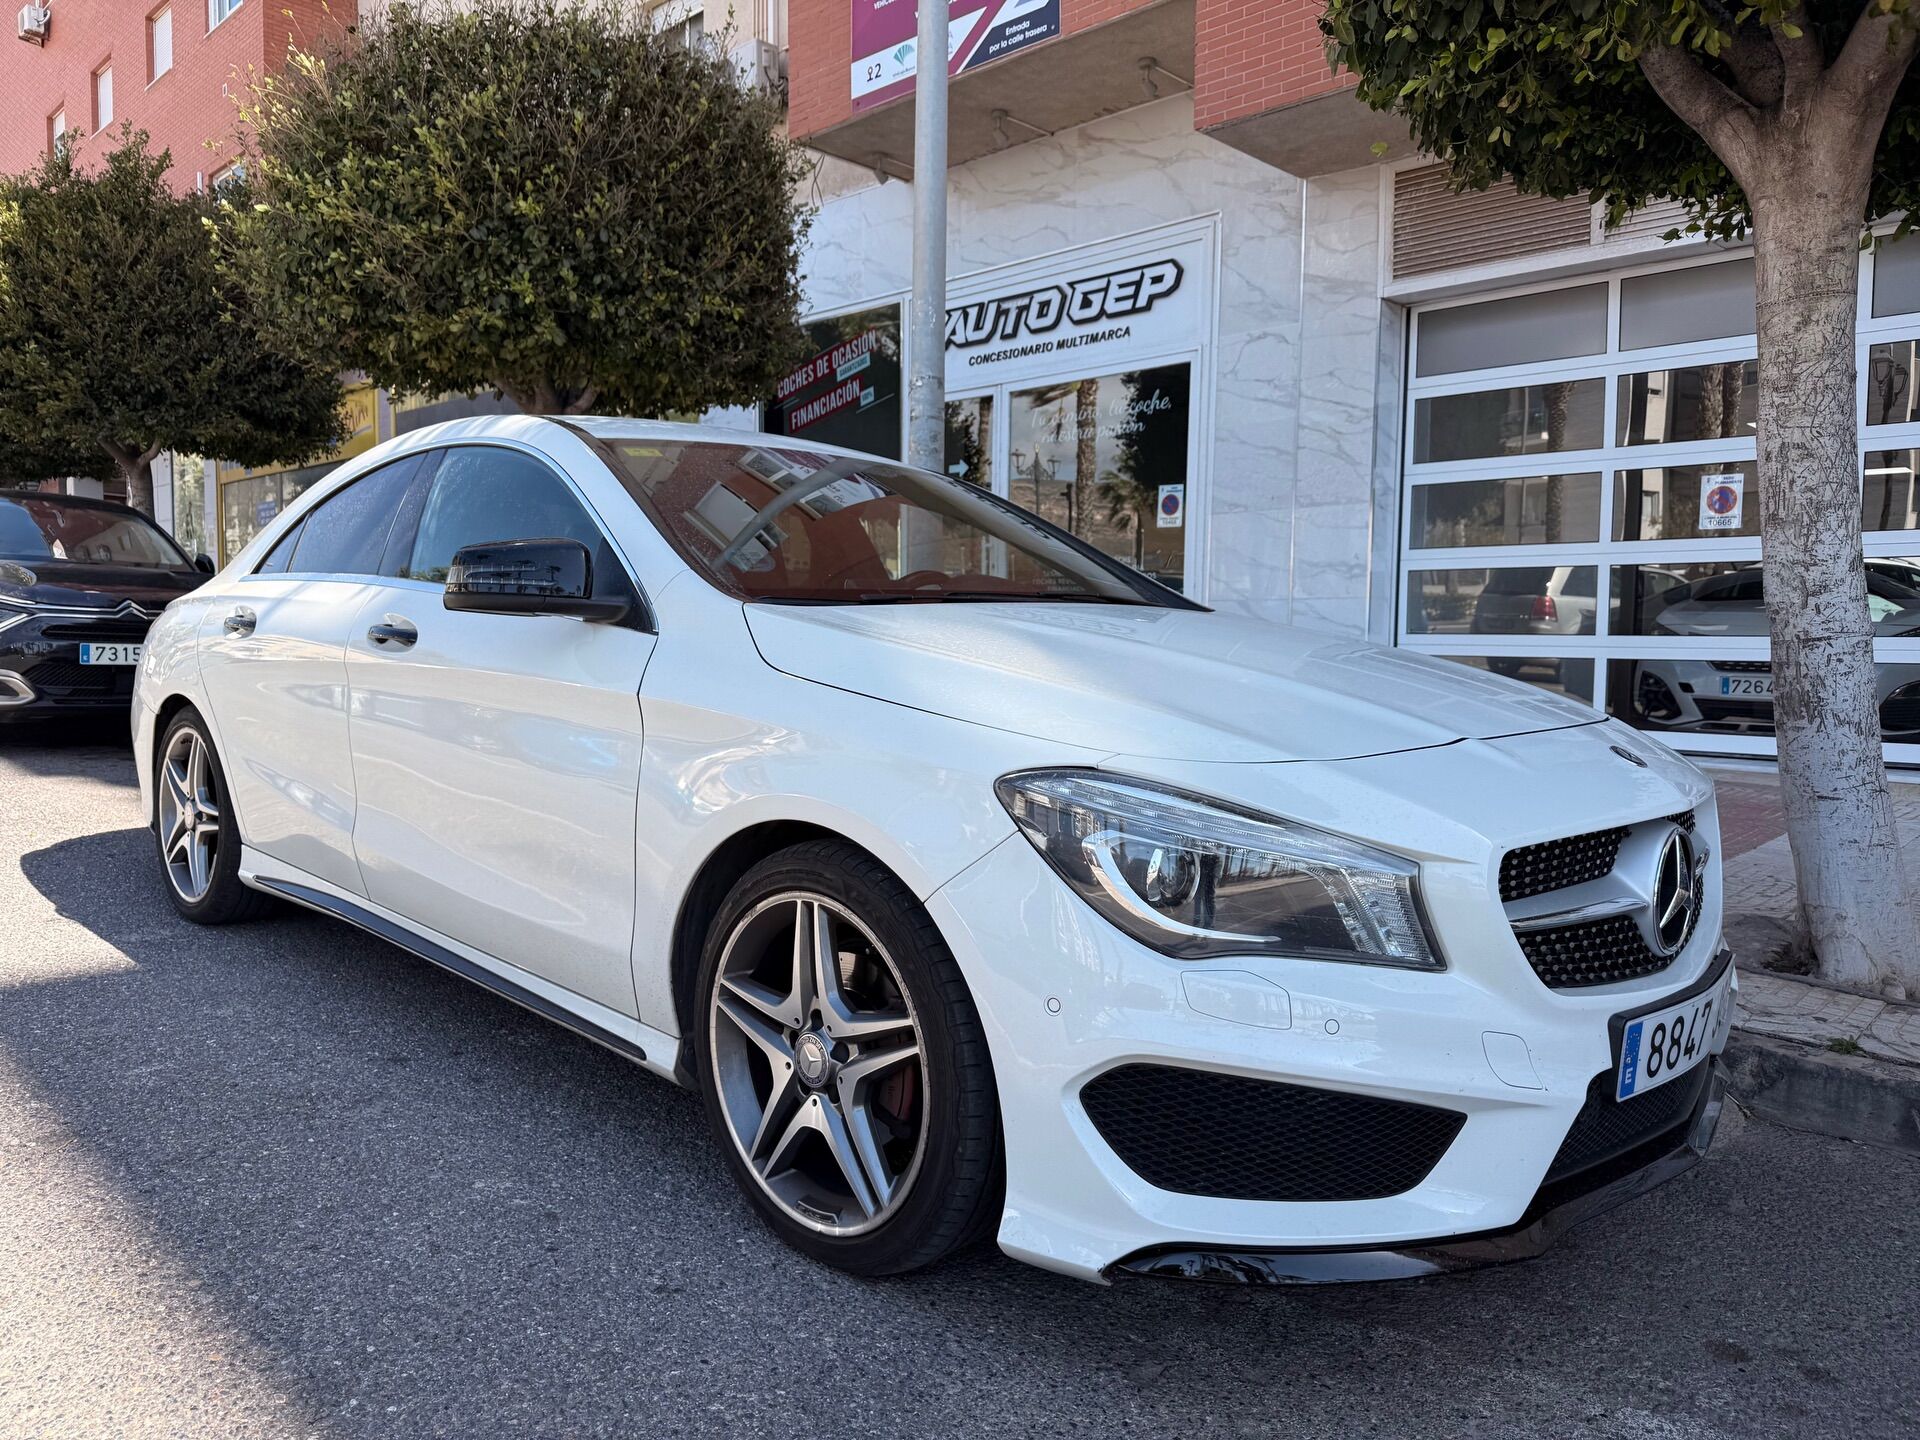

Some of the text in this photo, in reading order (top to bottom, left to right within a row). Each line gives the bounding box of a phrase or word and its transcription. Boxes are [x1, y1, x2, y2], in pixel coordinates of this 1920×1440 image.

[989, 24, 1047, 54] por la calle trasera
[1005, 20, 1030, 36] Entrada
[945, 258, 1184, 349] AUTO GEP
[777, 329, 877, 398] COCHES DE OCASIÓN
[968, 326, 1131, 366] CONCESIONARIO MULTIMARCA
[791, 379, 860, 430] FINANCIACIÓN
[1129, 389, 1172, 415] coche,
[95, 646, 141, 662] 7315
[1731, 679, 1773, 694] 7264
[1647, 998, 1713, 1078] 8847
